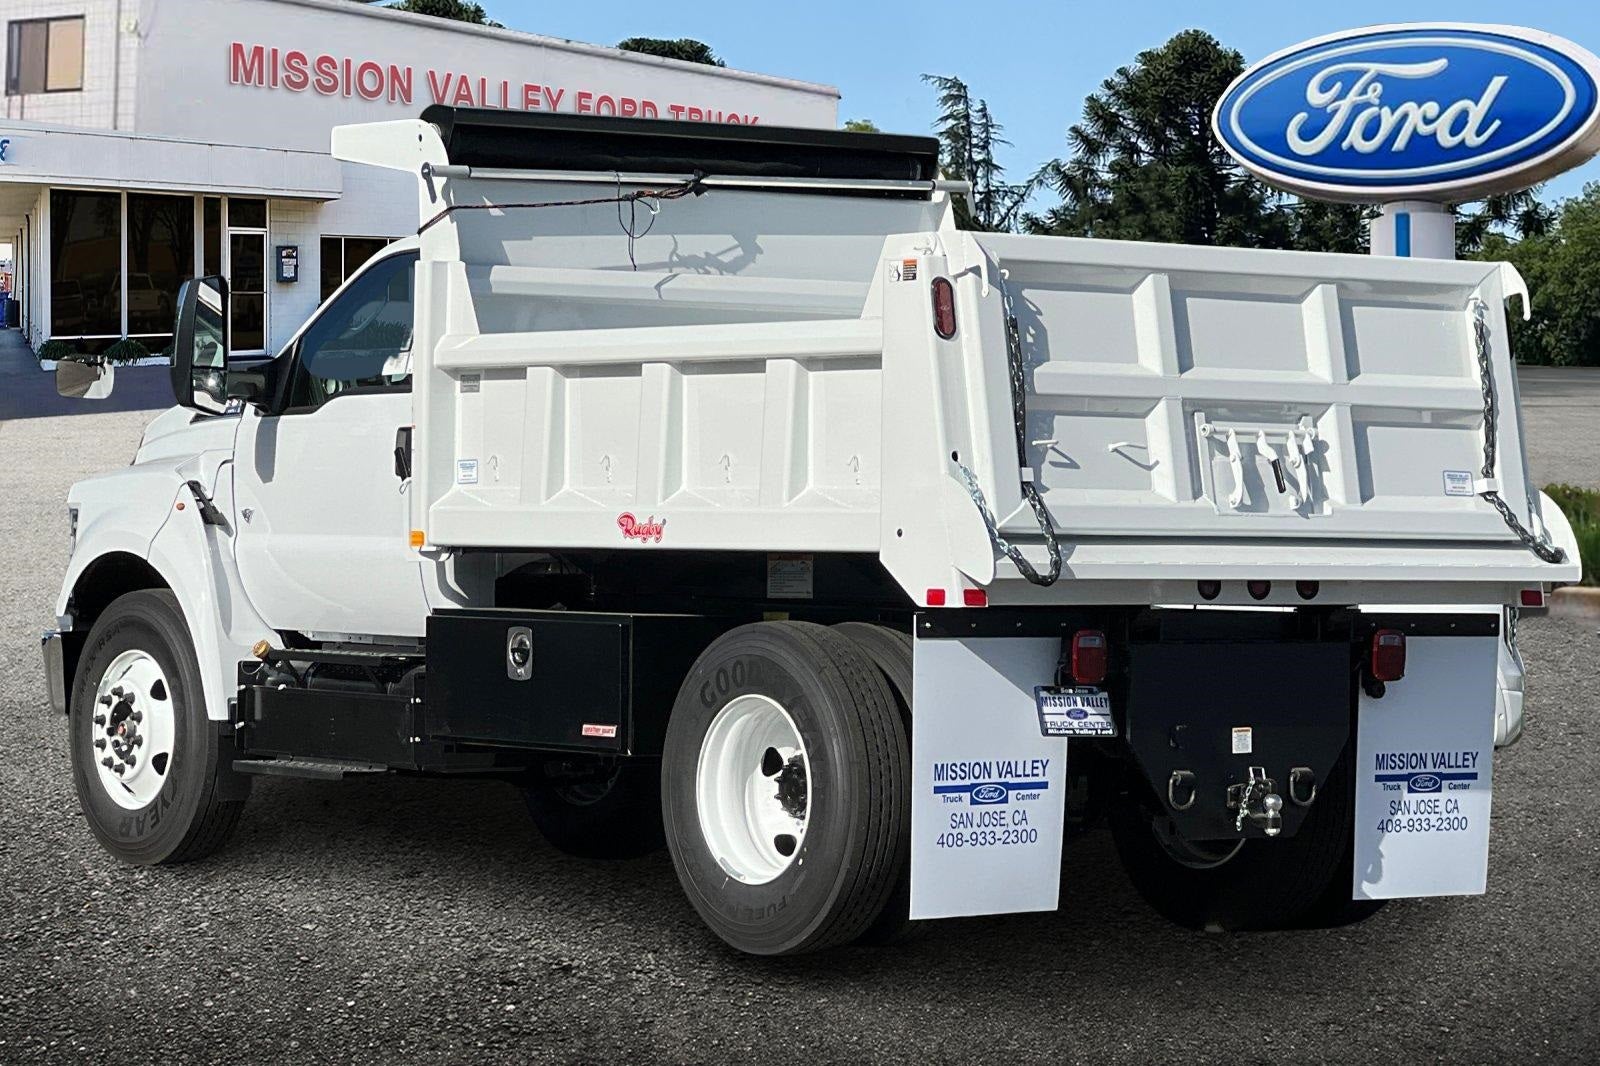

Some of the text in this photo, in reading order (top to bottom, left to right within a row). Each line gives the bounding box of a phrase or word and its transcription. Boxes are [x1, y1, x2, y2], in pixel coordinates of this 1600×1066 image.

[230, 42, 414, 104] MISSION
[427, 69, 565, 113] VALLEY
[576, 91, 660, 120] FORD
[1286, 57, 1509, 156] Ford
[617, 511, 667, 544] Rugby
[1040, 696, 1109, 708] MISSION VALLEY
[1044, 720, 1075, 728] TRUCK
[1375, 751, 1479, 770] MISSION VALLEY
[933, 759, 1050, 781] MISSION VALLEY
[1382, 782, 1471, 791] Truck Center
[1415, 776, 1435, 788] Ford
[942, 791, 1041, 804] Truck Center
[977, 786, 1000, 800] Ford
[1389, 798, 1460, 816] SAN JOSE, CA
[950, 809, 1029, 829] SAN JOSE, CA
[1377, 816, 1468, 834] 408-933-2300
[936, 828, 1038, 848] 408-933-2300
